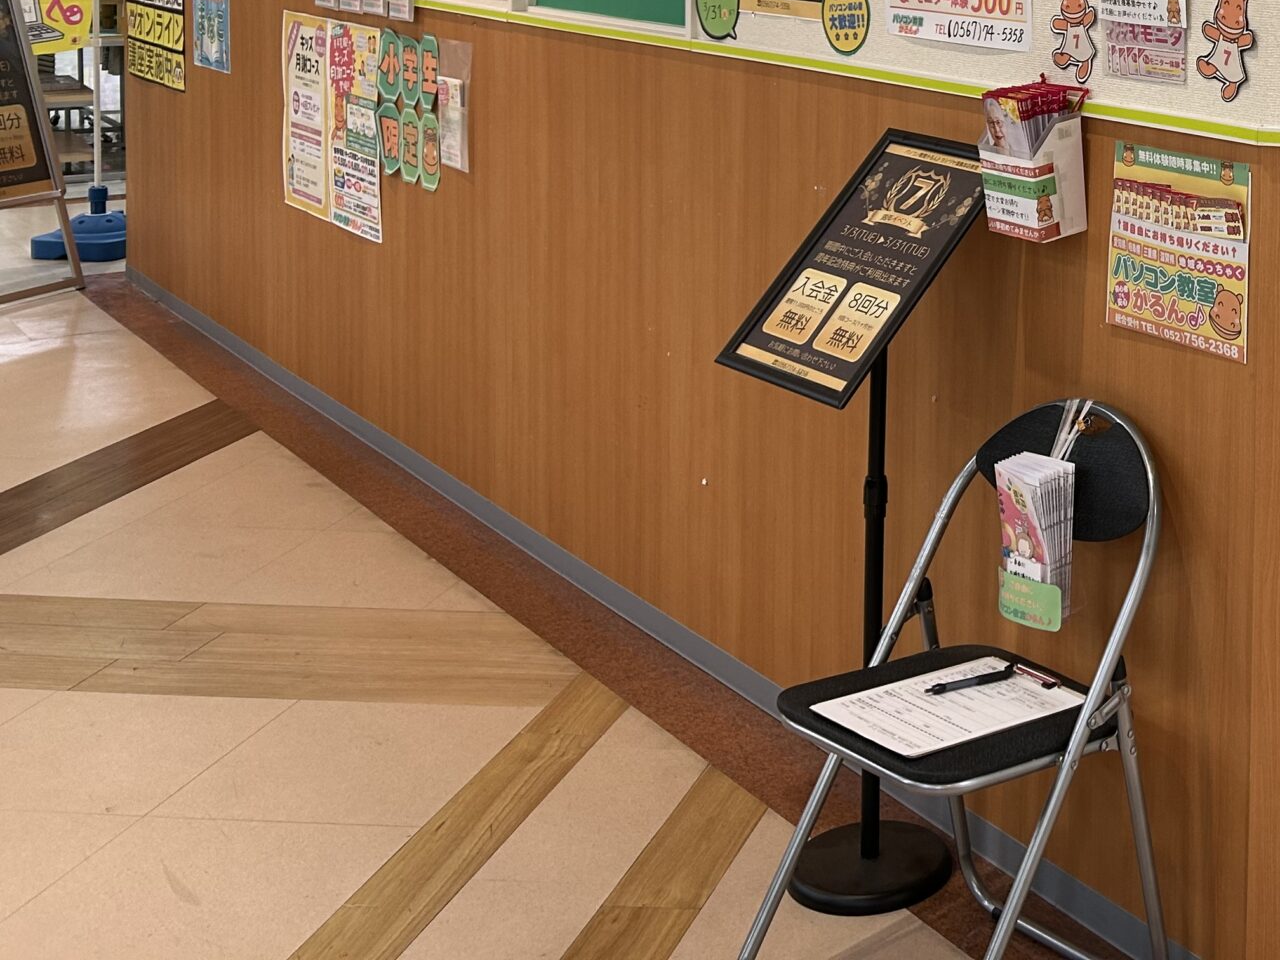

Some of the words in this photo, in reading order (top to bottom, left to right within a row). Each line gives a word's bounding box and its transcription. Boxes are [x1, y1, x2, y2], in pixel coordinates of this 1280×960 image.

[829, 14, 865, 30] 大歓迎!!
[1015, 2, 1024, 16] 円
[136, 12, 183, 45] オンライン
[935, 24, 946, 35] TEL
[947, 19, 1024, 43] (0567)74-5358
[1073, 34, 1079, 50] 7
[378, 43, 438, 94] 小学生
[1223, 49, 1232, 66] 7
[380, 117, 418, 168] 限定
[1138, 150, 1217, 175] 無料体験随時募集中!!
[900, 178, 935, 210] 7
[841, 224, 879, 245] 3/3(TUE)
[884, 234, 931, 259] 3/31(TUE)
[792, 276, 839, 305] 入会金
[1113, 253, 1218, 306] パソコン教室
[848, 292, 890, 320] 8回分
[1132, 288, 1187, 327] かるん
[775, 308, 811, 336] 無料
[826, 326, 864, 355] 無料
[1140, 321, 1159, 336] TEL
[1159, 326, 1239, 359] (052)756-2368
